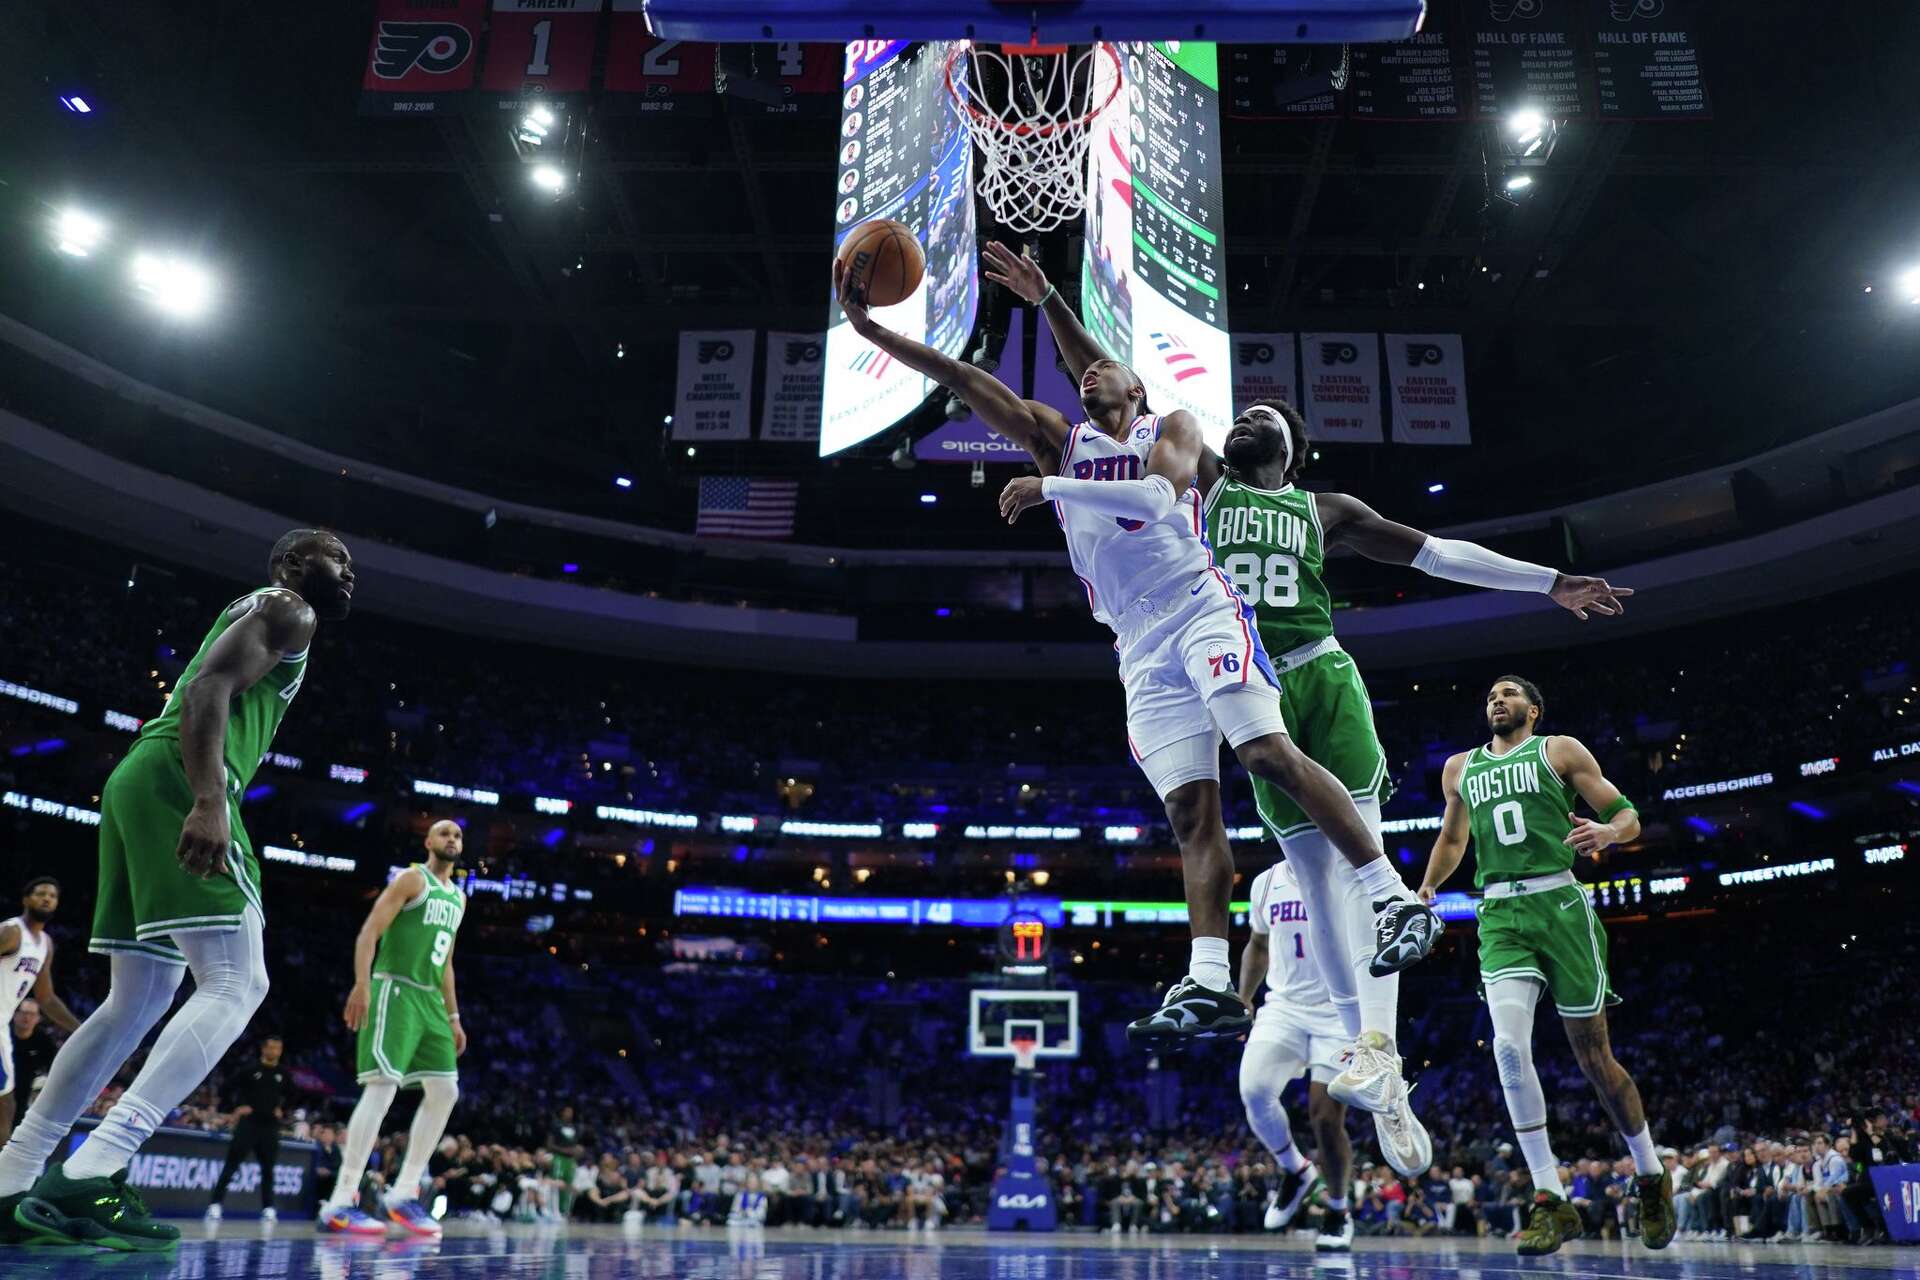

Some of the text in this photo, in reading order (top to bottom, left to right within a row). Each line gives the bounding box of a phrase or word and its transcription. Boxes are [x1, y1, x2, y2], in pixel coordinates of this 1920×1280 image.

[527, 20, 552, 75] 1
[1476, 33, 1566, 44] HALL OF FAME
[1598, 32, 1688, 43] HALL OF FAME
[1208, 300, 1214, 309] 2
[1205, 311, 1214, 323] 10
[1234, 385, 1288, 394] ONFERENCE
[1312, 385, 1370, 394] CONFERENCE
[1319, 375, 1362, 384] EASTERN
[1398, 386, 1456, 395] CONFERENCE
[1406, 376, 1448, 385] EASTERN
[1313, 394, 1369, 403] CHAMPIONS
[1400, 395, 1456, 405] CHAMPIONS
[1216, 506, 1308, 558] BOSTON
[1224, 552, 1299, 608] 88
[1208, 652, 1240, 678] 76
[1873, 741, 1920, 762] ALL DA
[1467, 762, 1540, 809] BOSTON
[1663, 772, 1774, 800] ACCESSORIES
[3, 792, 28, 808] ALL
[66, 806, 101, 825] EVER
[1493, 800, 1528, 846] 0
[1719, 858, 1835, 886] STREETWEAR
[430, 929, 453, 967] 9
[1294, 932, 1305, 958] 1
[126, 1153, 225, 1190] MERICAN
